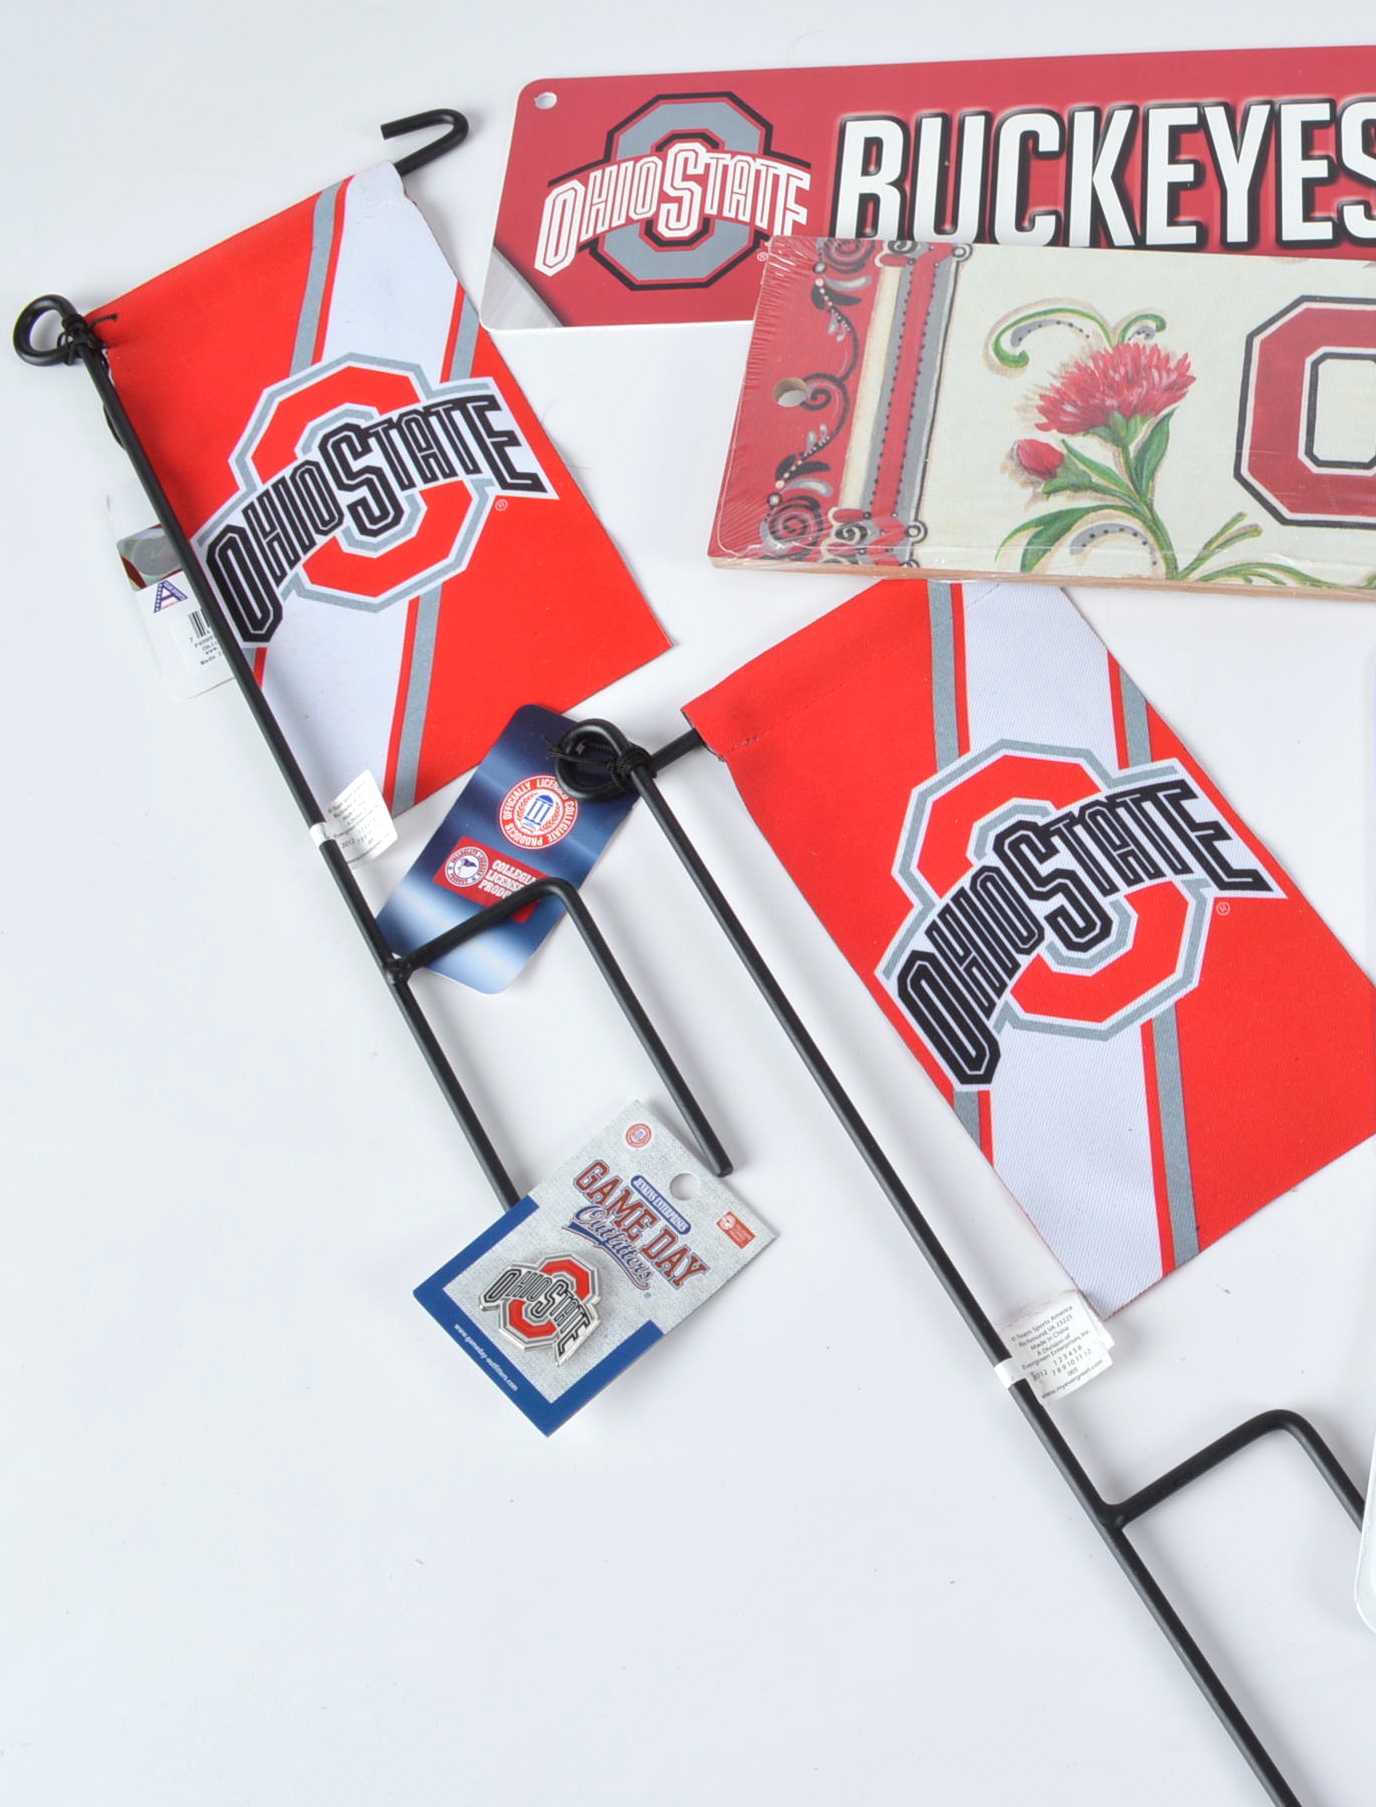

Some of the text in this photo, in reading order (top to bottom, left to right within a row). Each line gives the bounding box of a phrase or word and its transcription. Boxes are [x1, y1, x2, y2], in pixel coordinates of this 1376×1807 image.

[485, 870, 525, 892] LICENS
[492, 860, 537, 885] COLLEGIA
[573, 1159, 711, 1290] GAME DAY
